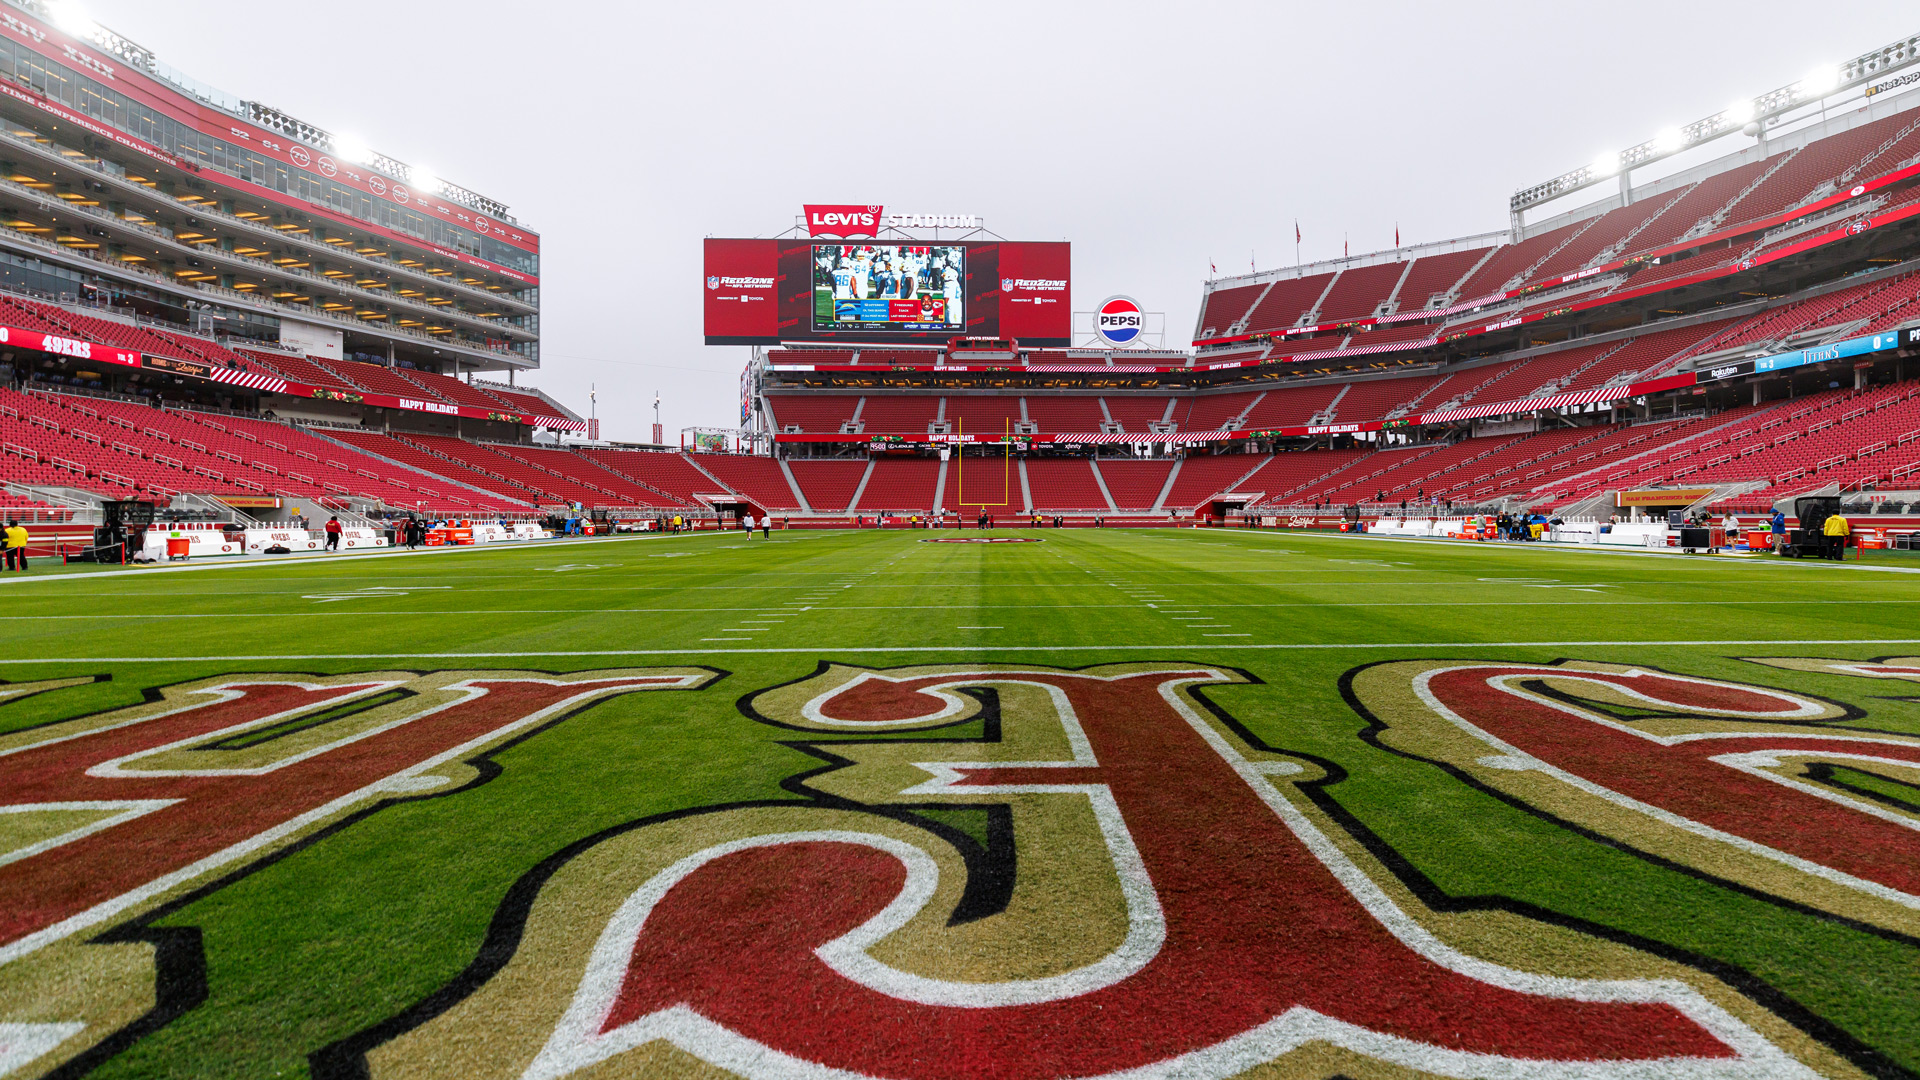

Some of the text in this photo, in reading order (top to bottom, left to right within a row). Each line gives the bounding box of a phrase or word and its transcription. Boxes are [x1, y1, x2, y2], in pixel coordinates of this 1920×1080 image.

[1878, 72, 1920, 92] NetApp
[38, 101, 114, 139] CONFERENCE
[116, 135, 177, 166] CHAMPIONS
[889, 214, 976, 228] STADIUM
[1562, 267, 1601, 282] HAPPY HOLIDAYS
[1100, 316, 1140, 326] PEPSI
[1485, 318, 1522, 332] HAPPY HOLIDAYS
[42, 335, 91, 358] 49ERS
[127, 354, 134, 364] 3
[1769, 360, 1774, 369] 3
[1801, 344, 1840, 365] TITANS
[1873, 336, 1881, 349] 0
[1711, 367, 1738, 377] Rakuten
[400, 399, 458, 414] HAPPY HOLIDAYS
[1308, 424, 1359, 434] HAPPY HOLIDAYS
[1870, 495, 1887, 503] 117
[1262, 517, 1277, 526] HOME
[271, 533, 290, 541] 49ERS
